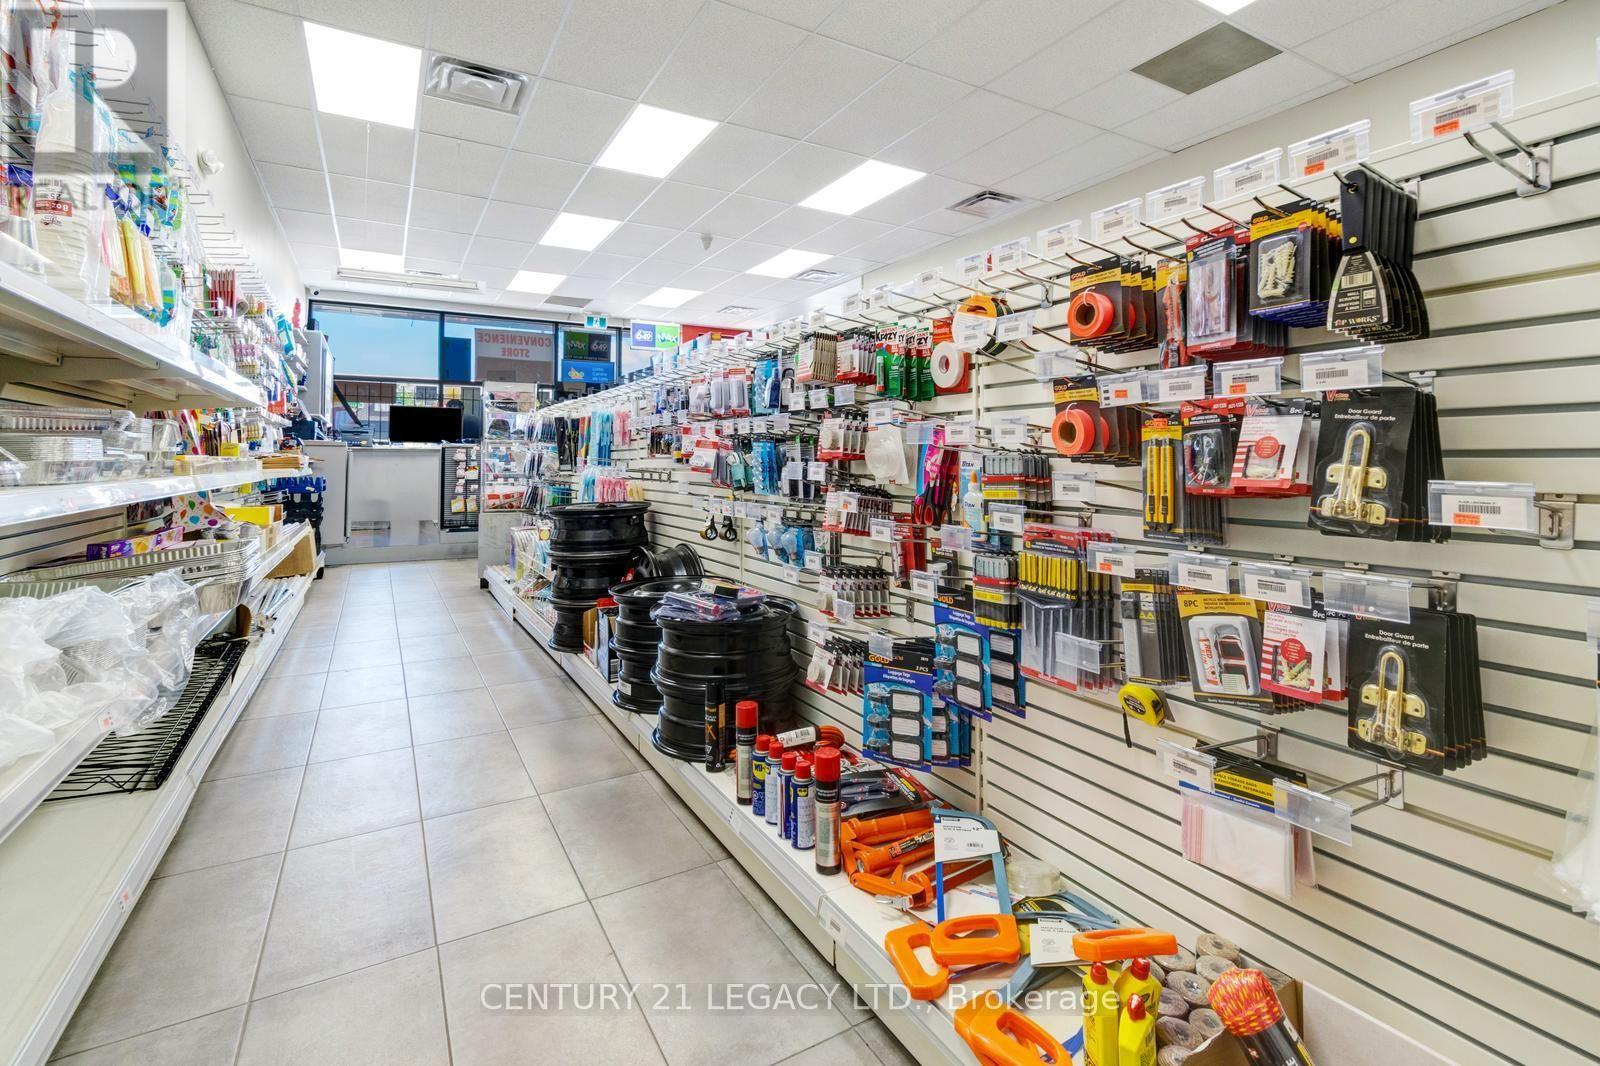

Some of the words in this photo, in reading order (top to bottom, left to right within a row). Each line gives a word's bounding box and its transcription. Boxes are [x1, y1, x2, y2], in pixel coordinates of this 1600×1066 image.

[1183, 599, 1199, 608] 8PC
[1312, 610, 1326, 619] 8PC
[1394, 633, 1414, 641] Guard
[1412, 642, 1430, 650] porte
[868, 654, 890, 664] GOLD
